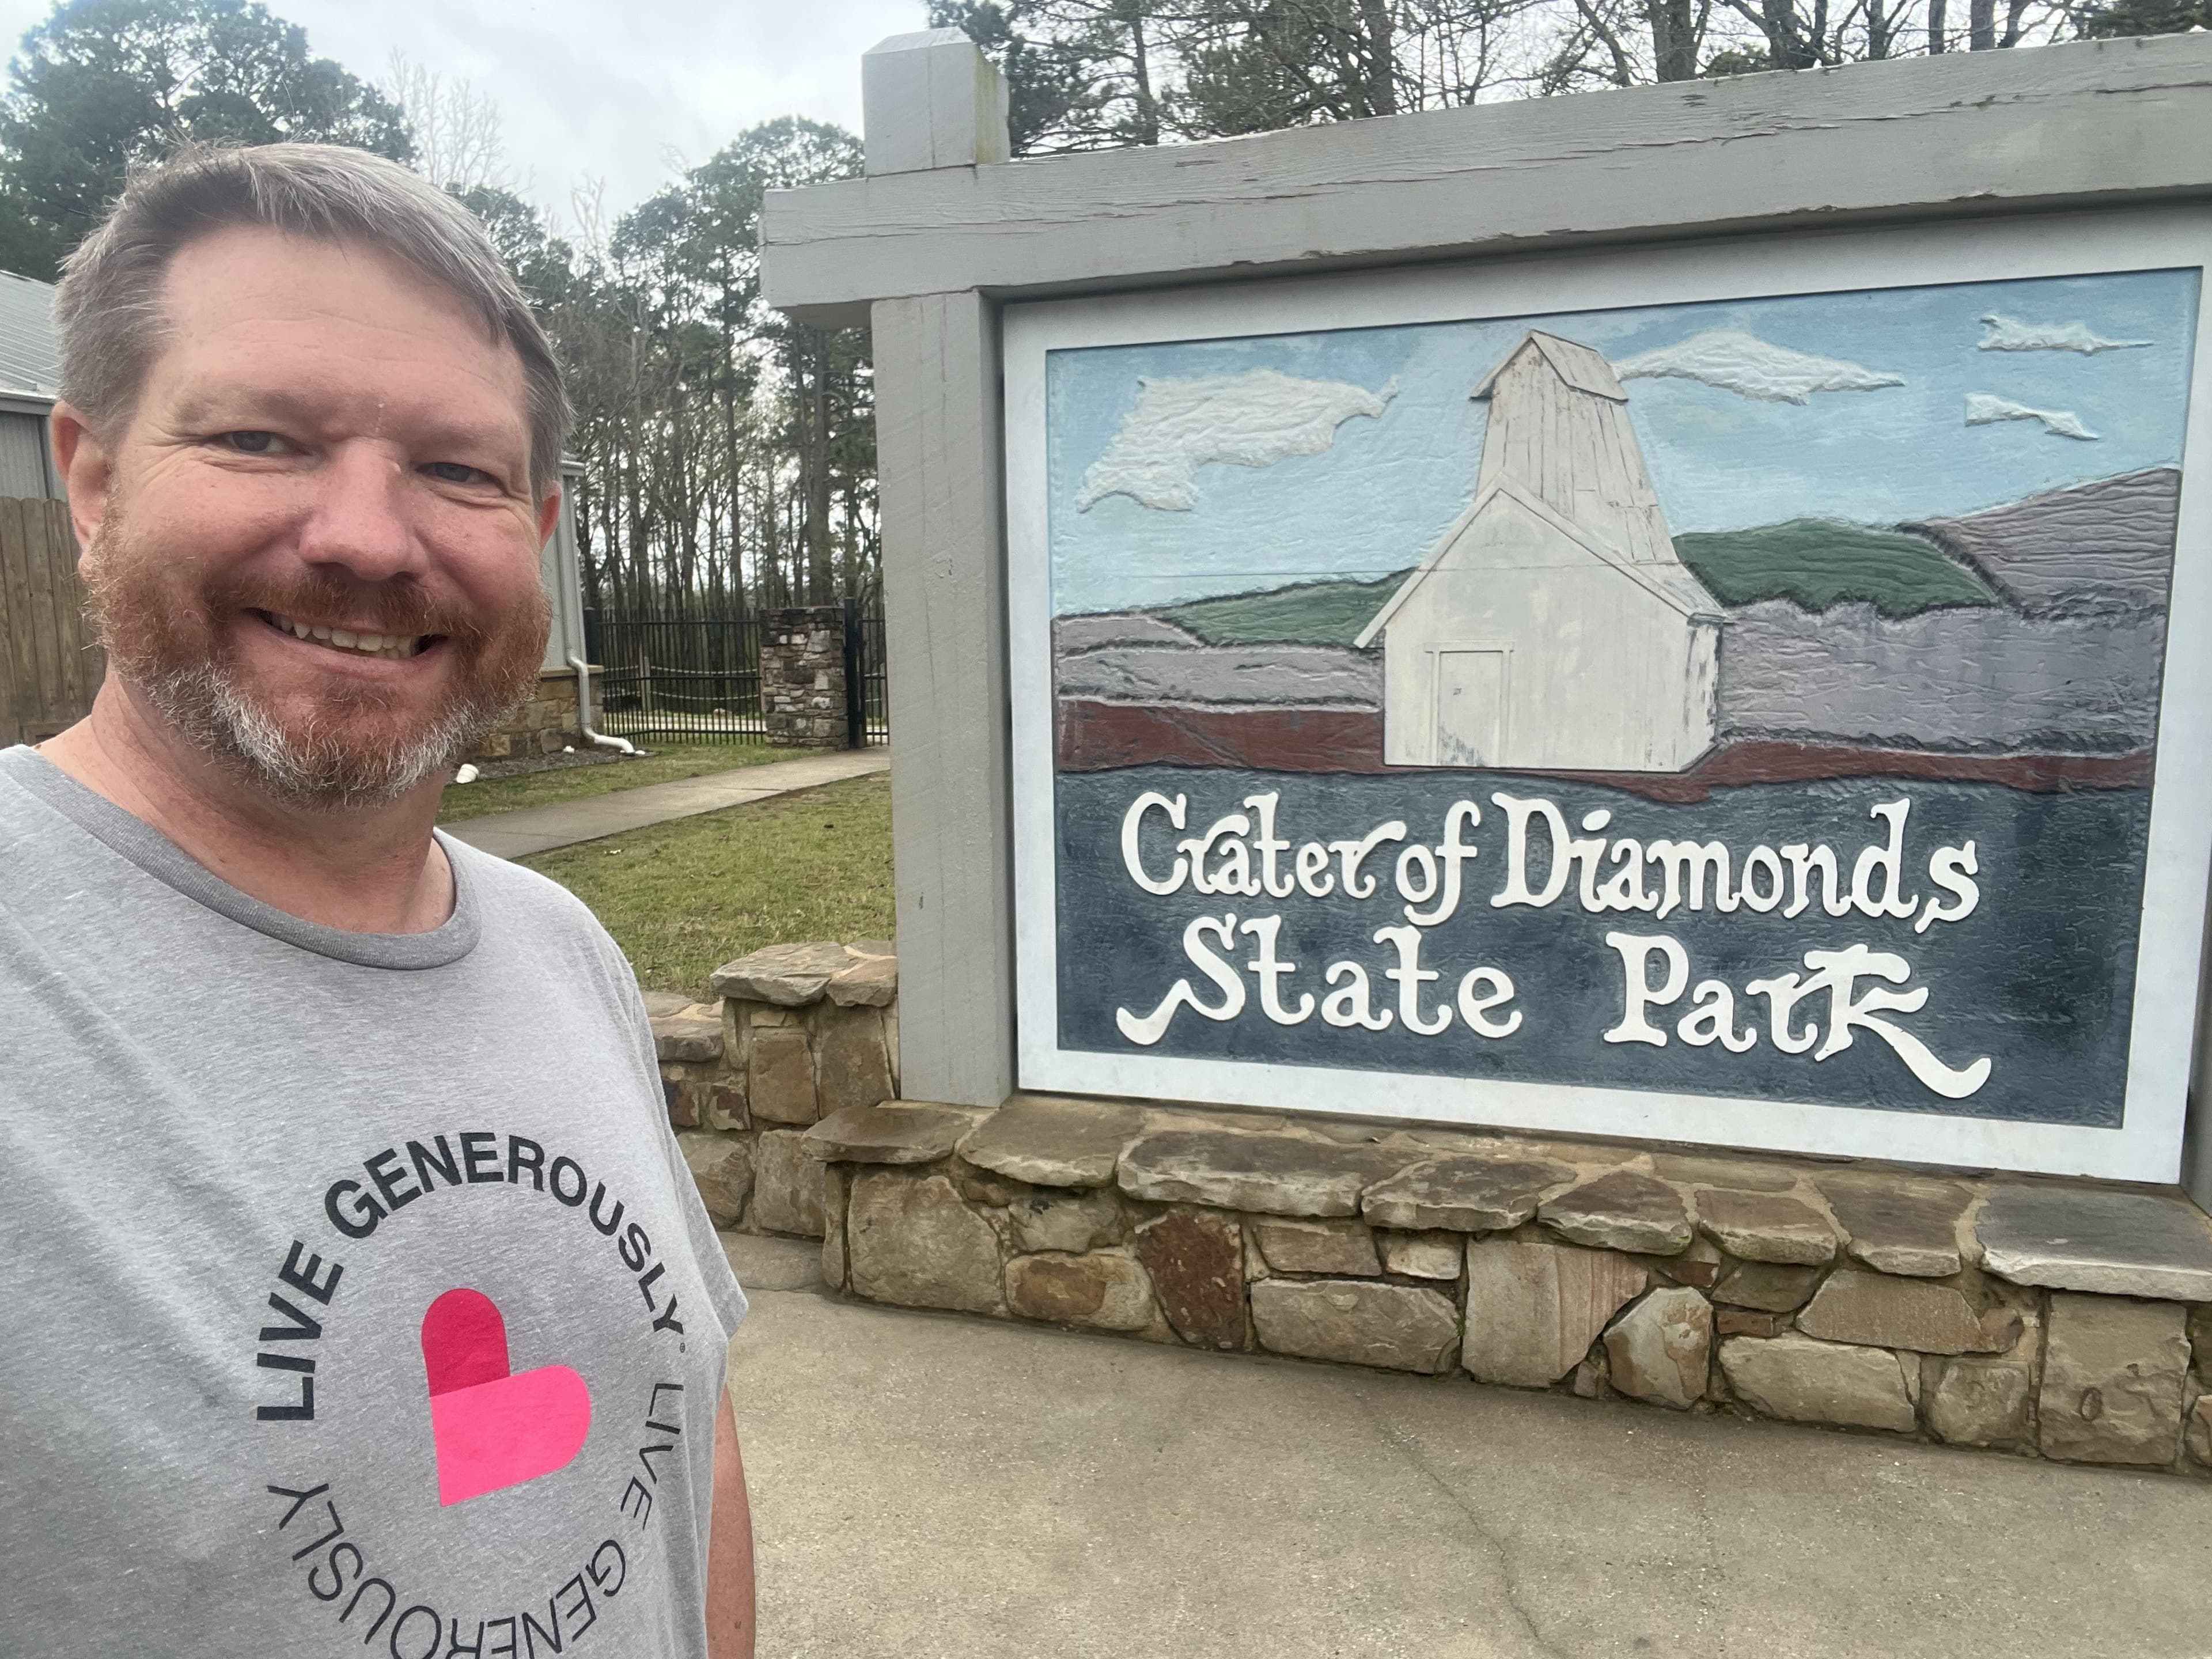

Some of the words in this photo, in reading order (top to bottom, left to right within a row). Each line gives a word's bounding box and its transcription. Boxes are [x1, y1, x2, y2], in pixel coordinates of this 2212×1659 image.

[1122, 791, 1407, 899] Crater
[1396, 800, 1480, 926] of
[1490, 792, 1979, 934] Diamonds
[1116, 912, 1522, 1046] State
[257, 1240, 344, 1421] LIVE
[620, 1382, 684, 1530] LIVE
